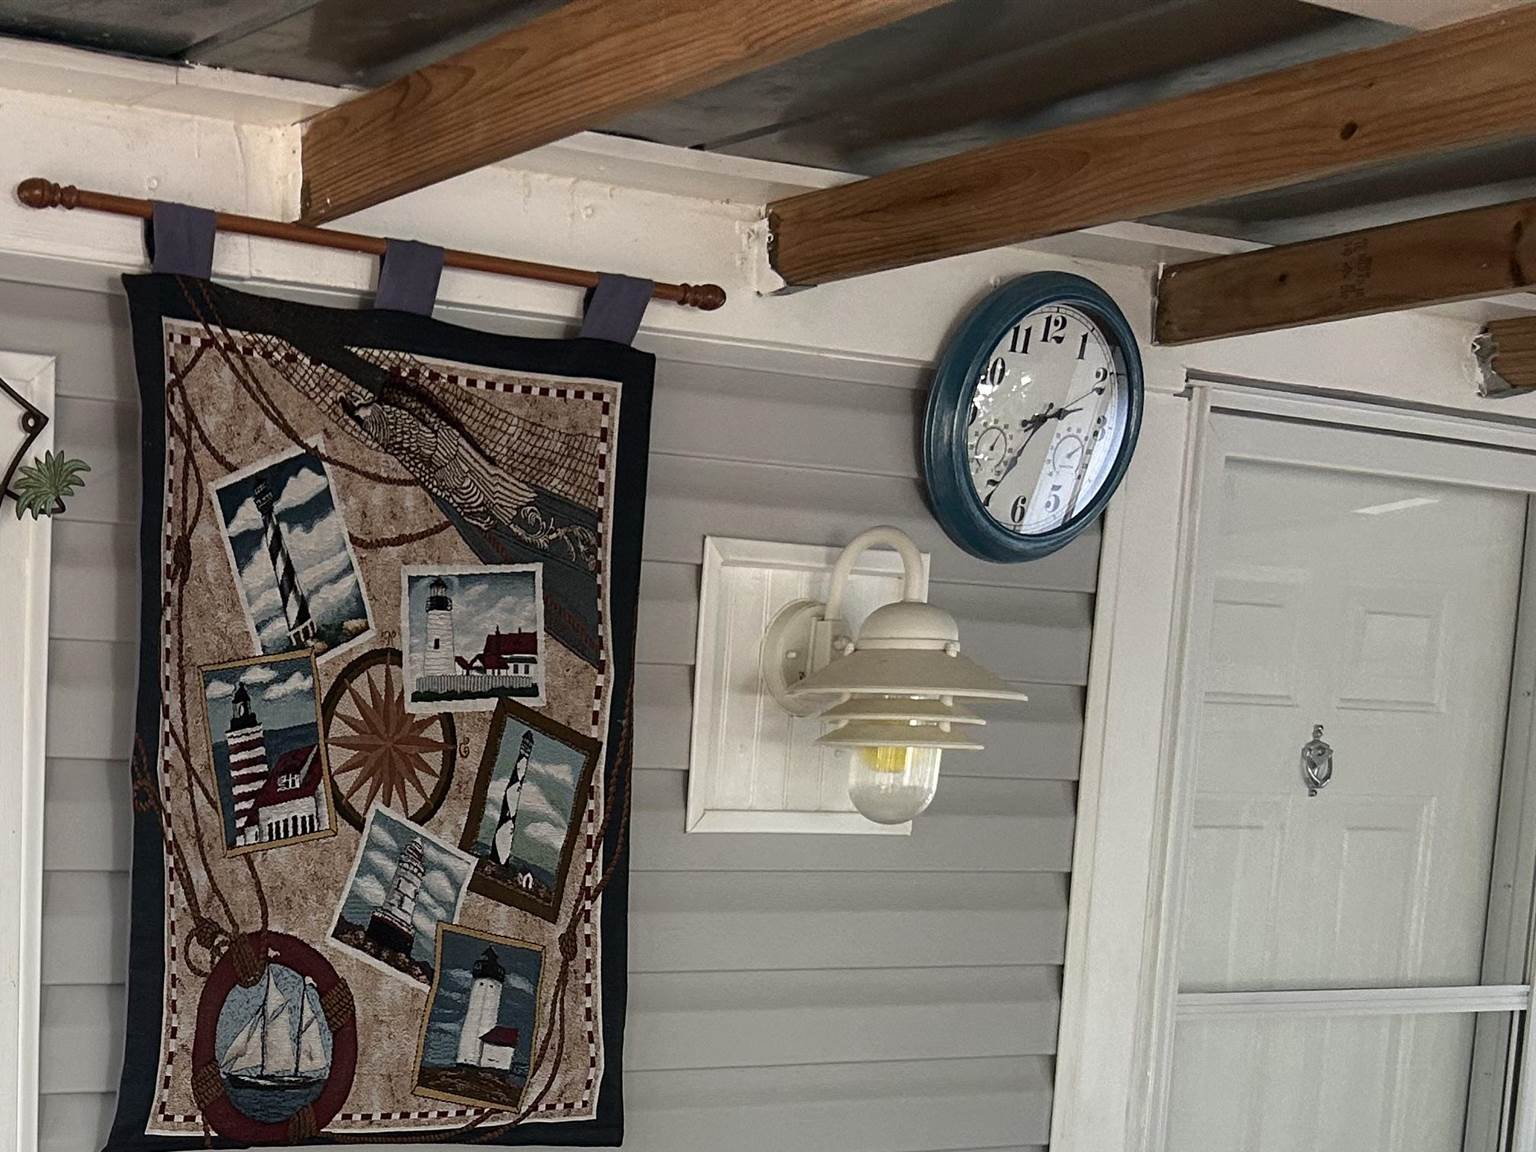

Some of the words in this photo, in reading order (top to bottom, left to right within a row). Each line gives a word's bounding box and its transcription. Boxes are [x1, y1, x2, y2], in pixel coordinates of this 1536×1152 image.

[1009, 325, 1032, 354] 11
[1040, 314, 1067, 344] 12
[1076, 332, 1089, 360] 1
[1094, 367, 1108, 395] 2
[1093, 415, 1108, 441] 3
[982, 478, 1001, 507] 7
[1045, 485, 1062, 512] 5
[1010, 495, 1027, 523] 6
